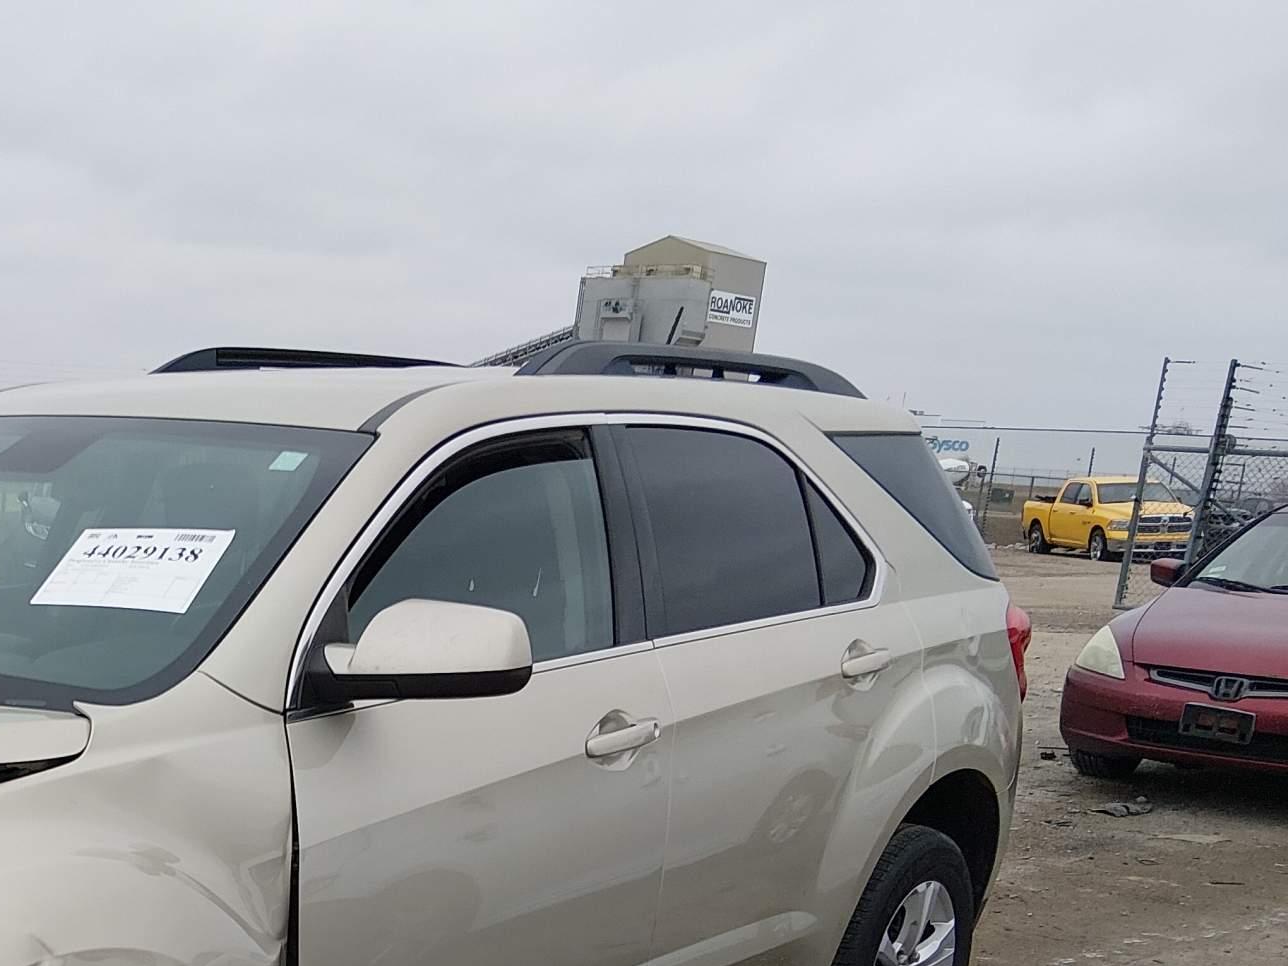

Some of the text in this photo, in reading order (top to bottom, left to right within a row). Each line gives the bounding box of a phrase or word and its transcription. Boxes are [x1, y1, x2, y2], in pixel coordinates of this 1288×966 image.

[710, 296, 753, 314] ROANOKE
[709, 313, 751, 326] CONCRETE PRODUCTS
[83, 545, 203, 563] 44029138
